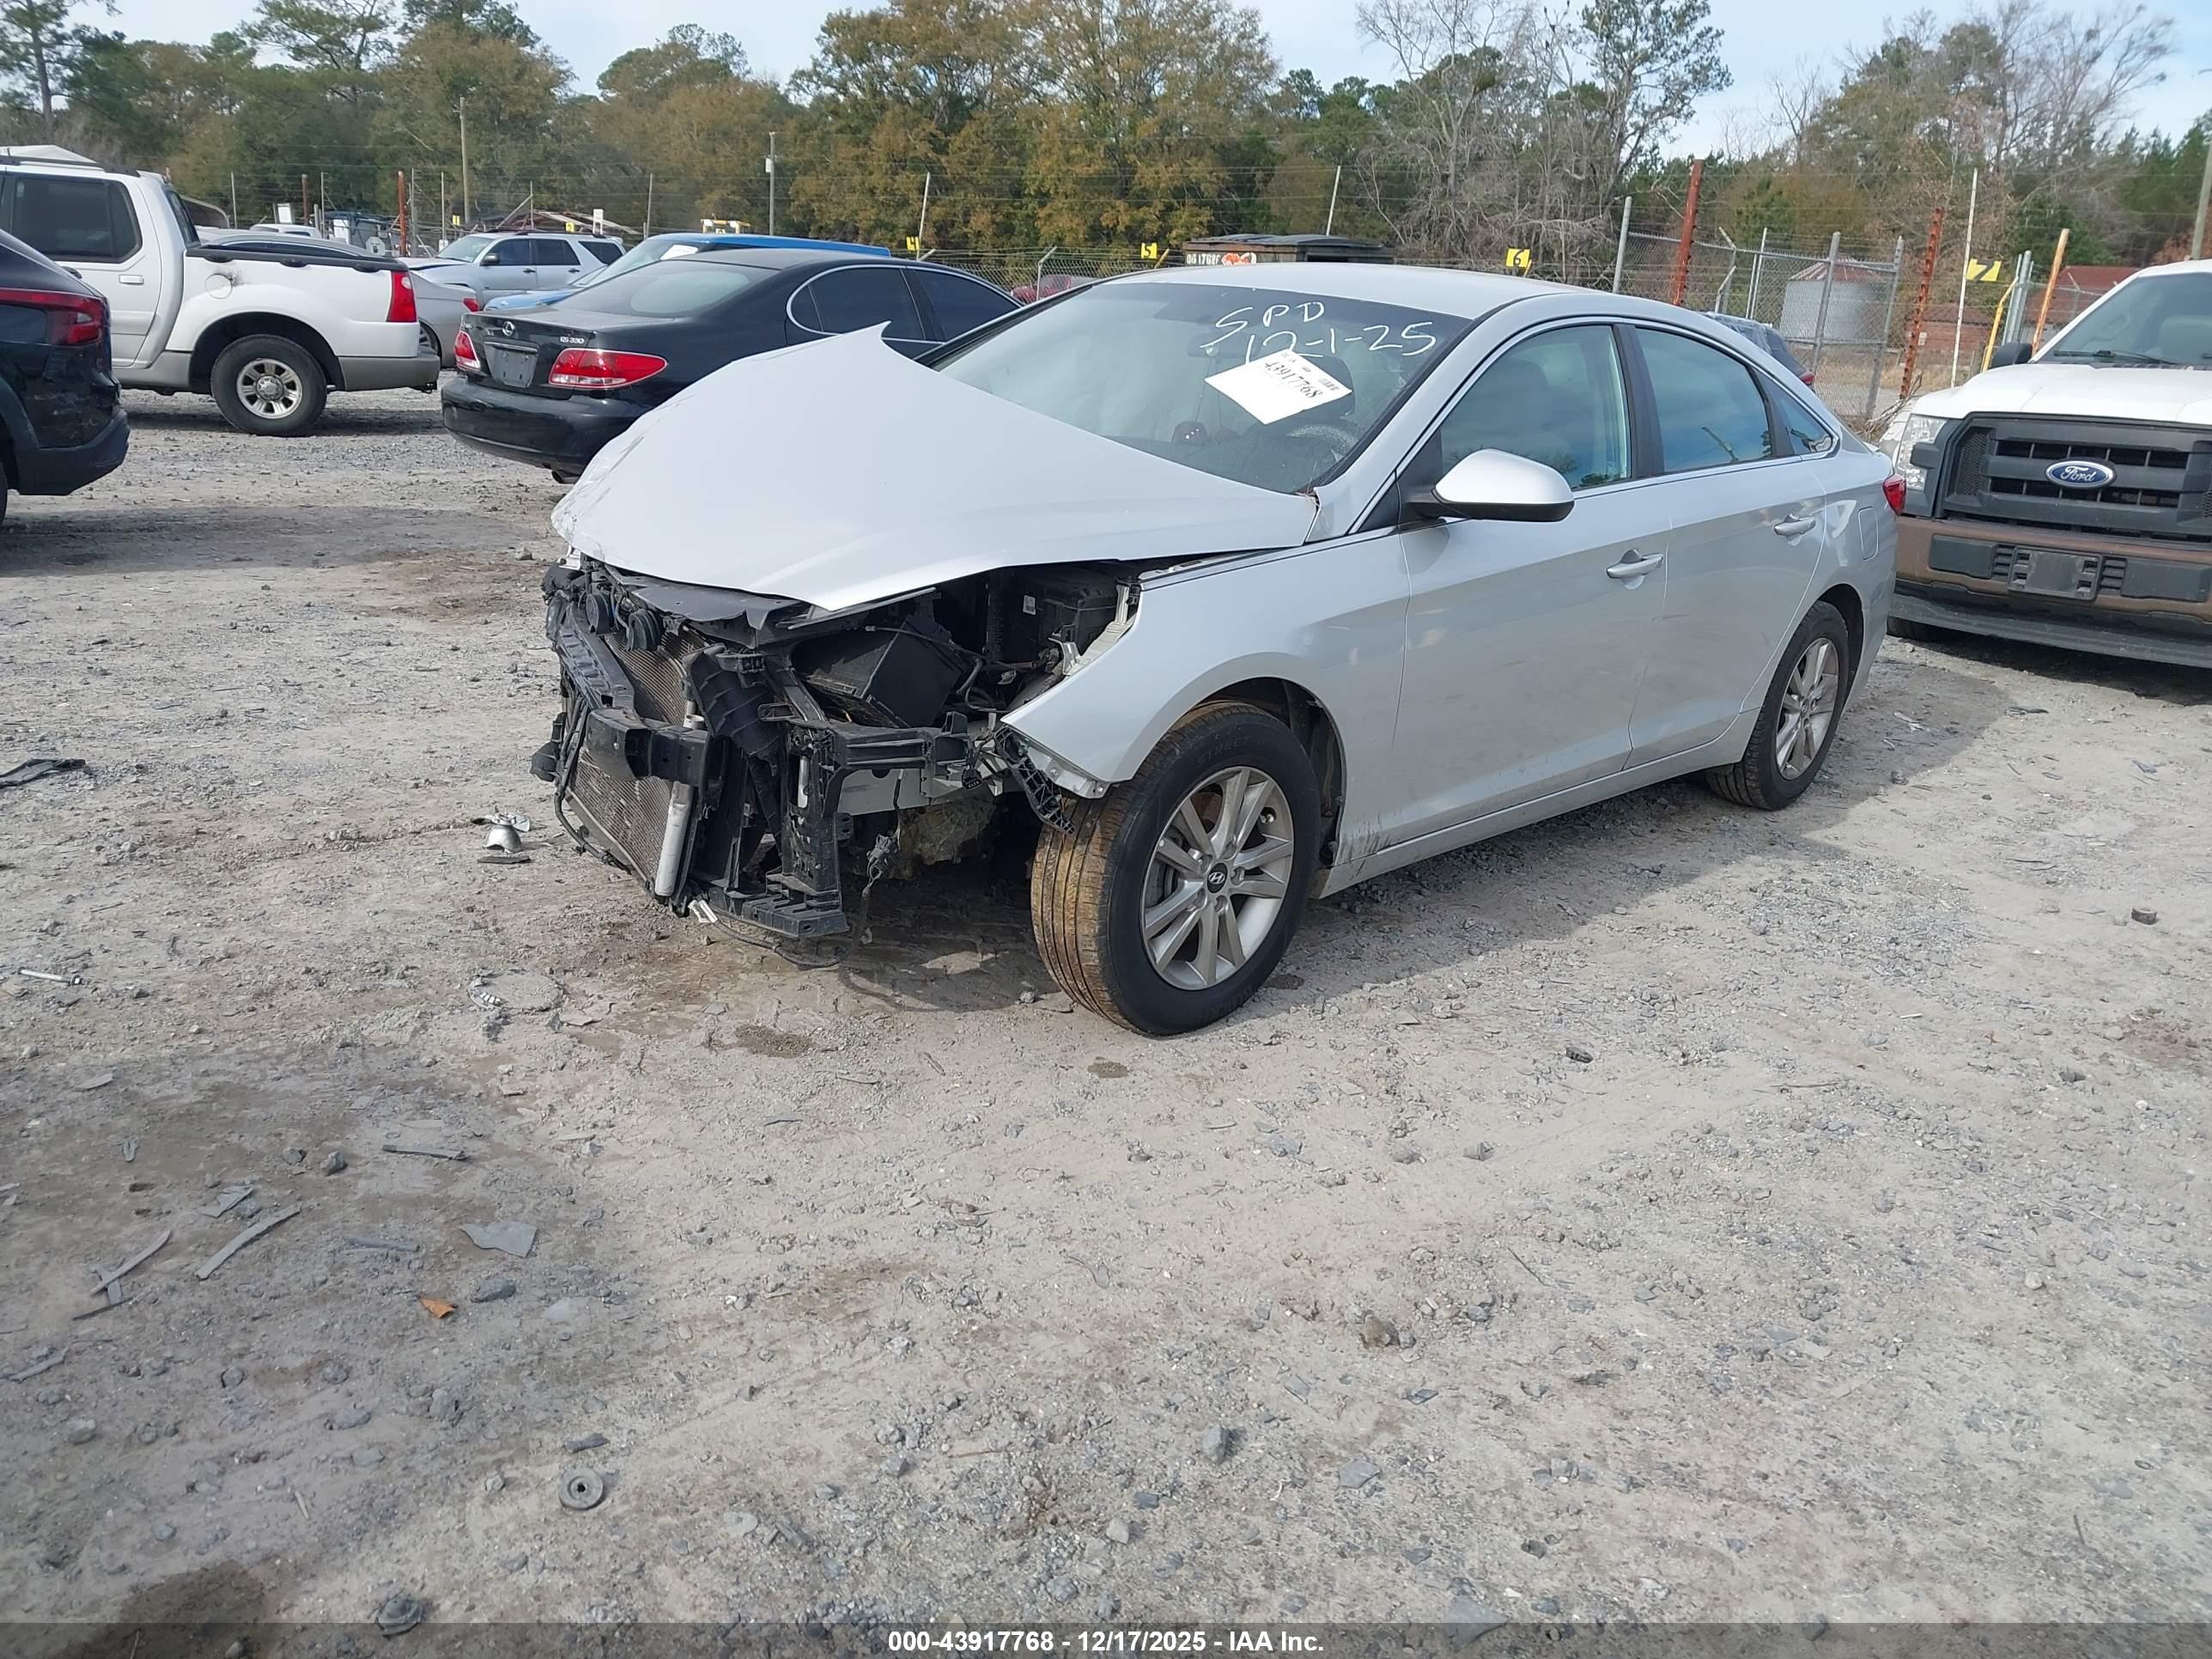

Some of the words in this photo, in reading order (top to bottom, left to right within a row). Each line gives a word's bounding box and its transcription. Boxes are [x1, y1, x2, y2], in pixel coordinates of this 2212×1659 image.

[1513, 248, 1524, 266] 6
[1972, 260, 1994, 282] 7
[1200, 301, 1325, 349] SPD
[1245, 313, 1437, 364] 12-1-25
[1265, 362, 1323, 398] 43917768
[2061, 465, 2097, 482] Ford
